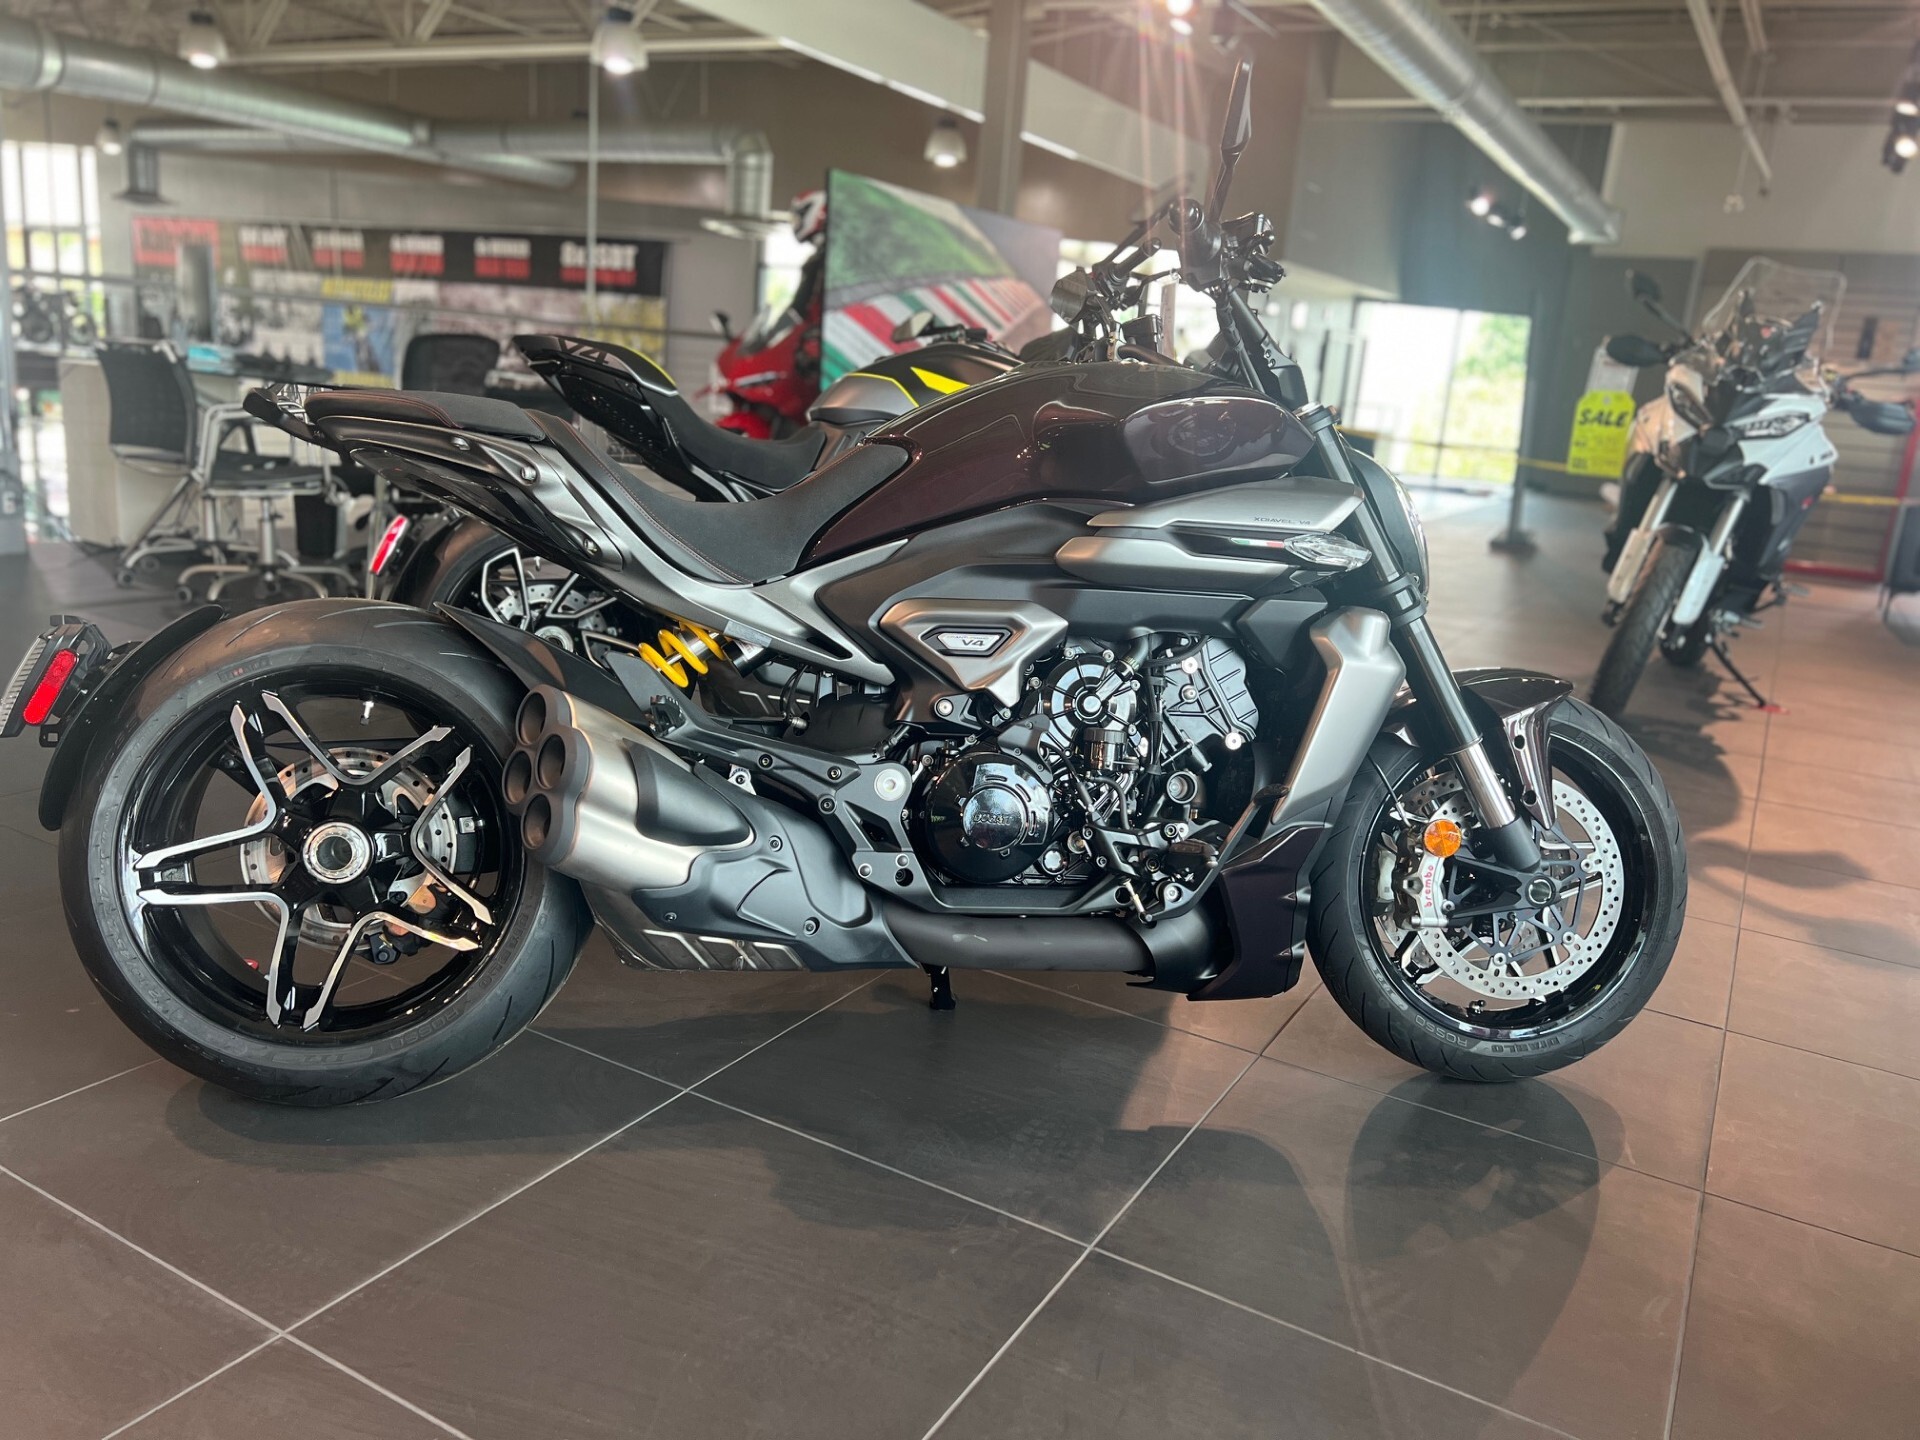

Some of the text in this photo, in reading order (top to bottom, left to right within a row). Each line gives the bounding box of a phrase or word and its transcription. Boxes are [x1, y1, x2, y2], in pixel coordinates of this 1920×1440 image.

[558, 337, 609, 365] V4
[1579, 408, 1629, 428] SALE
[1254, 516, 1295, 525] XDIAVEL
[962, 639, 984, 647] V4
[1424, 865, 1434, 907] brembo
[1414, 1014, 1469, 1048] ROSSO
[1490, 1036, 1561, 1054] DIABLO
